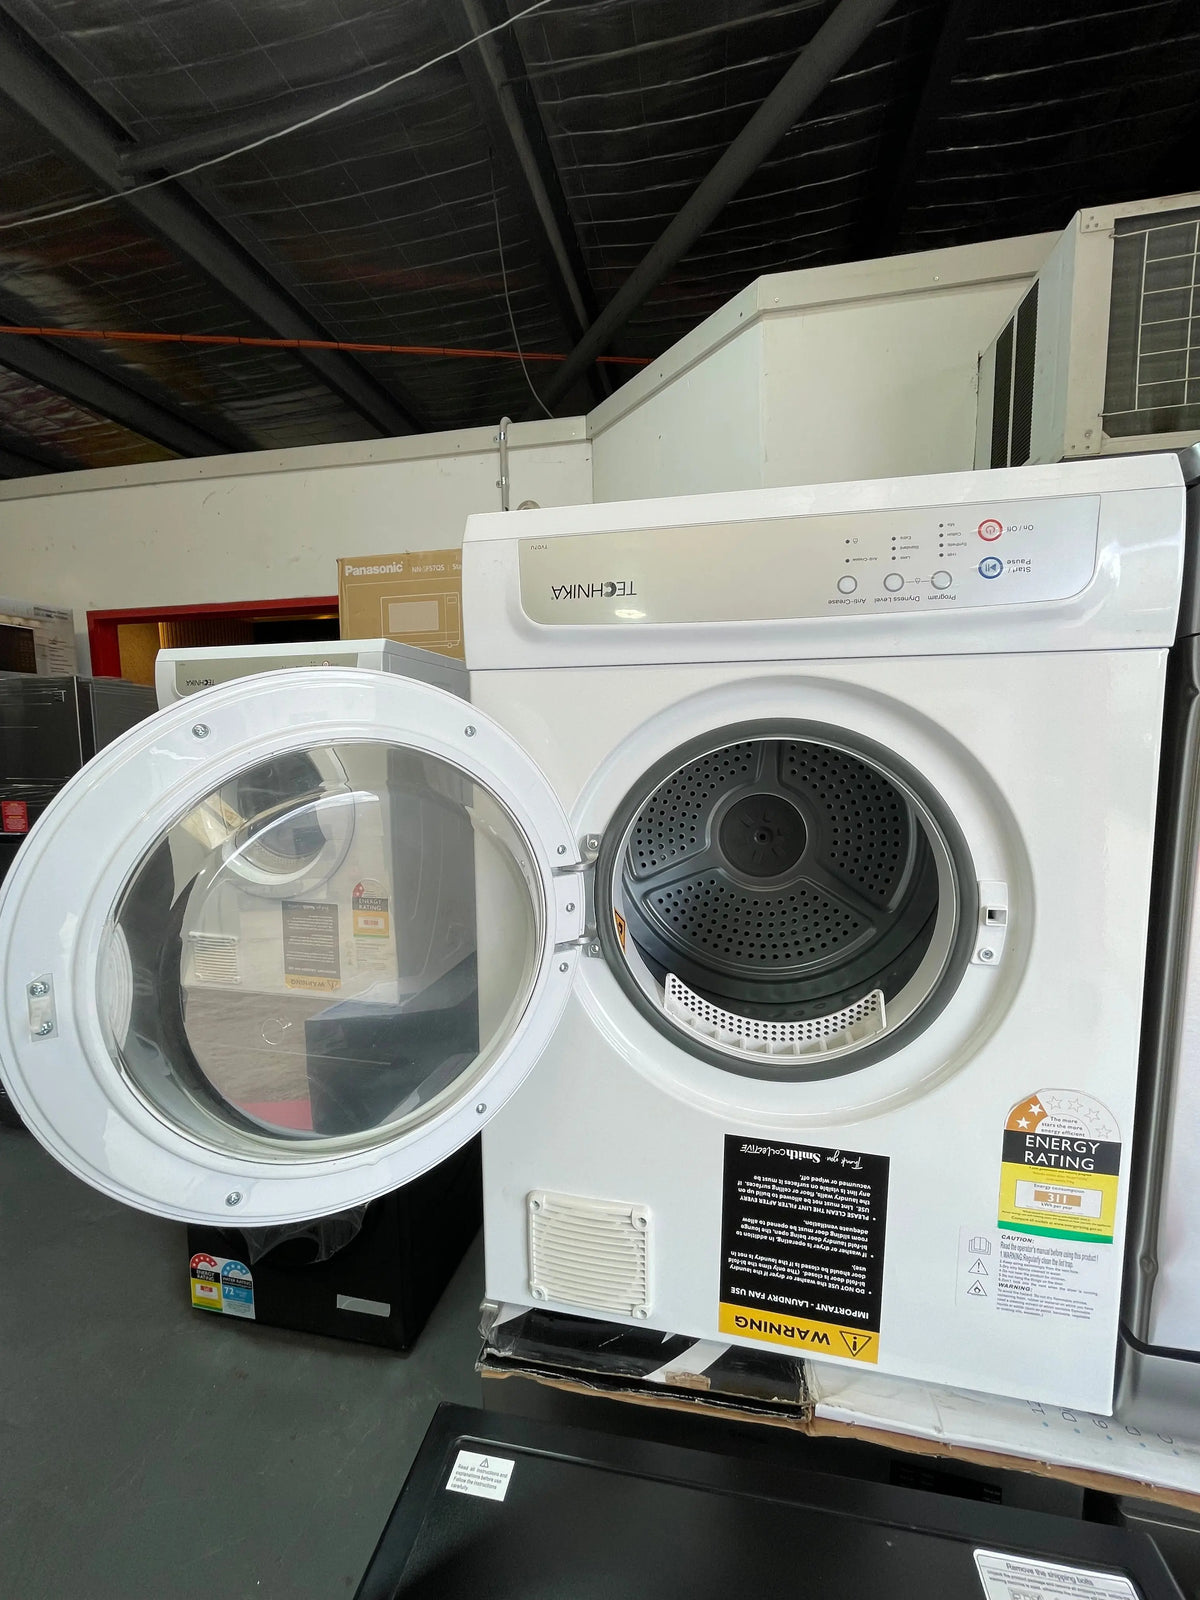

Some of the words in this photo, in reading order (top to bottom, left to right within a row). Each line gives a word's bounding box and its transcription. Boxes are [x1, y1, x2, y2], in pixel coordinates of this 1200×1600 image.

[1007, 558, 1031, 566] Pause
[345, 562, 403, 576] Panasonic
[552, 580, 636, 601] TECHNIKA
[893, 594, 920, 603] Dryness
[928, 592, 956, 601] Program
[828, 597, 866, 606] Anti-Crease
[186, 679, 216, 687] TECHNIKA
[1025, 1135, 1100, 1155] ENERGY
[841, 1154, 863, 1170] Thank
[1024, 1150, 1094, 1171] RATING
[784, 1180, 809, 1189] surfaces
[811, 1176, 830, 1184] wiped
[772, 1184, 791, 1194] ceiling
[820, 1185, 840, 1194] visible
[838, 1180, 871, 1190] vacuumed
[756, 1190, 771, 1198] build
[779, 1194, 802, 1203] allowed
[1047, 1193, 1067, 1204] 311
[740, 1195, 758, 1203] EVERY
[759, 1198, 777, 1206] AFTER
[834, 1194, 858, 1204] laundry
[778, 1201, 797, 1209] FILTER
[798, 1204, 812, 1212] LINT
[826, 1209, 846, 1217] CLEAN
[847, 1212, 869, 1221] PLEASE
[742, 1217, 758, 1225] allow
[766, 1221, 788, 1229] opened
[741, 1223, 760, 1232] lounge
[839, 1226, 868, 1235] adequate
[743, 1232, 768, 1241] addition
[790, 1231, 807, 1240] being
[807, 1235, 822, 1243] door
[830, 1230, 850, 1240] sliding
[1001, 1234, 1034, 1244] CAUTION:
[813, 1242, 830, 1251] dryer
[823, 1237, 847, 1247] laundry
[848, 1242, 868, 1251] bi-fold
[838, 1248, 862, 1257] washer
[1000, 1241, 1010, 1249] Read
[1017, 1244, 1036, 1254] operator's
[1051, 1249, 1063, 1257] before
[1063, 1251, 1074, 1260] using
[1082, 1253, 1096, 1264] product
[728, 1257, 746, 1266] bi-fold
[754, 1254, 777, 1264] laundry
[1041, 1257, 1051, 1265] clean
[730, 1263, 752, 1273] laundry
[753, 1267, 763, 1275] the
[773, 1264, 786, 1273] only
[787, 1267, 800, 1275] (The
[801, 1263, 820, 1272] closed
[197, 1273, 214, 1281] RATING
[769, 1271, 785, 1280] dryer
[830, 1268, 850, 1277] should
[851, 1272, 866, 1280] door
[794, 1274, 816, 1285] washer
[816, 1278, 827, 1288] the
[846, 1278, 865, 1287] bi-fold
[828, 1282, 840, 1290] USE
[840, 1283, 854, 1292] NOT
[855, 1286, 865, 1294] DO
[998, 1283, 1032, 1292] WARNING:
[224, 1287, 234, 1295] 72
[731, 1286, 746, 1296] USE
[748, 1290, 765, 1300] FAN
[767, 1293, 809, 1308] LAUNDRY
[816, 1303, 869, 1319] IMPORTANT
[735, 1315, 830, 1346] WARNING
[1006, 1563, 1034, 1575] Remove
[1035, 1568, 1047, 1577] the
[1048, 1571, 1076, 1584] shipping
[1077, 1577, 1094, 1586] bolts
